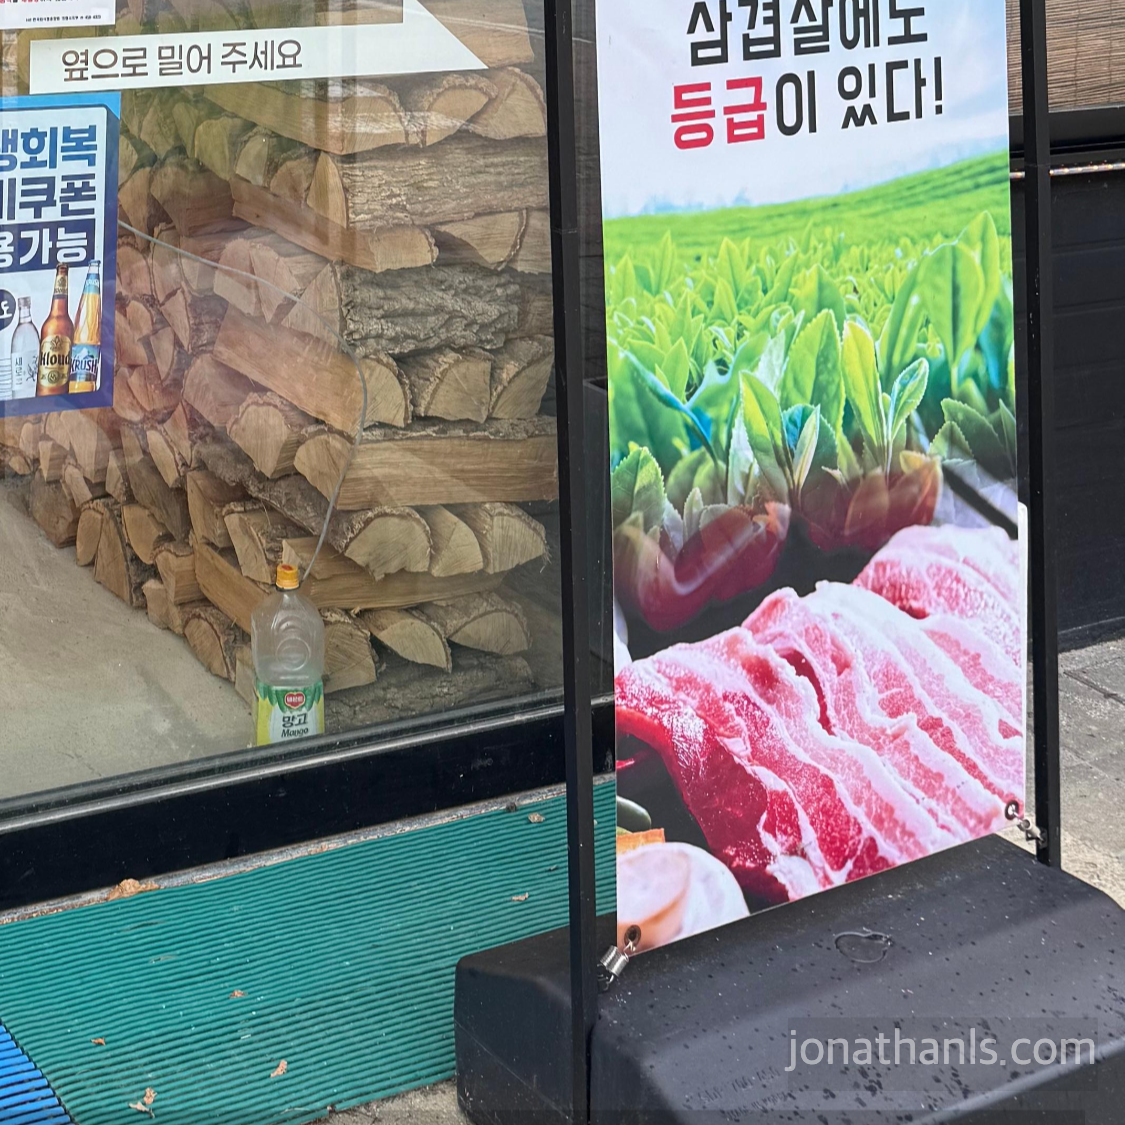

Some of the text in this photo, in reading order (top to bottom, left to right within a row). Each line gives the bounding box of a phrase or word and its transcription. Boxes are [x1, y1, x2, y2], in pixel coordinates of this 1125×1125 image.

[61, 39, 303, 82] 옆으로 밀어 주세요
[671, 56, 944, 150] 등급이 있다!
[281, 727, 309, 738] Mango
[282, 713, 308, 728] 망고
